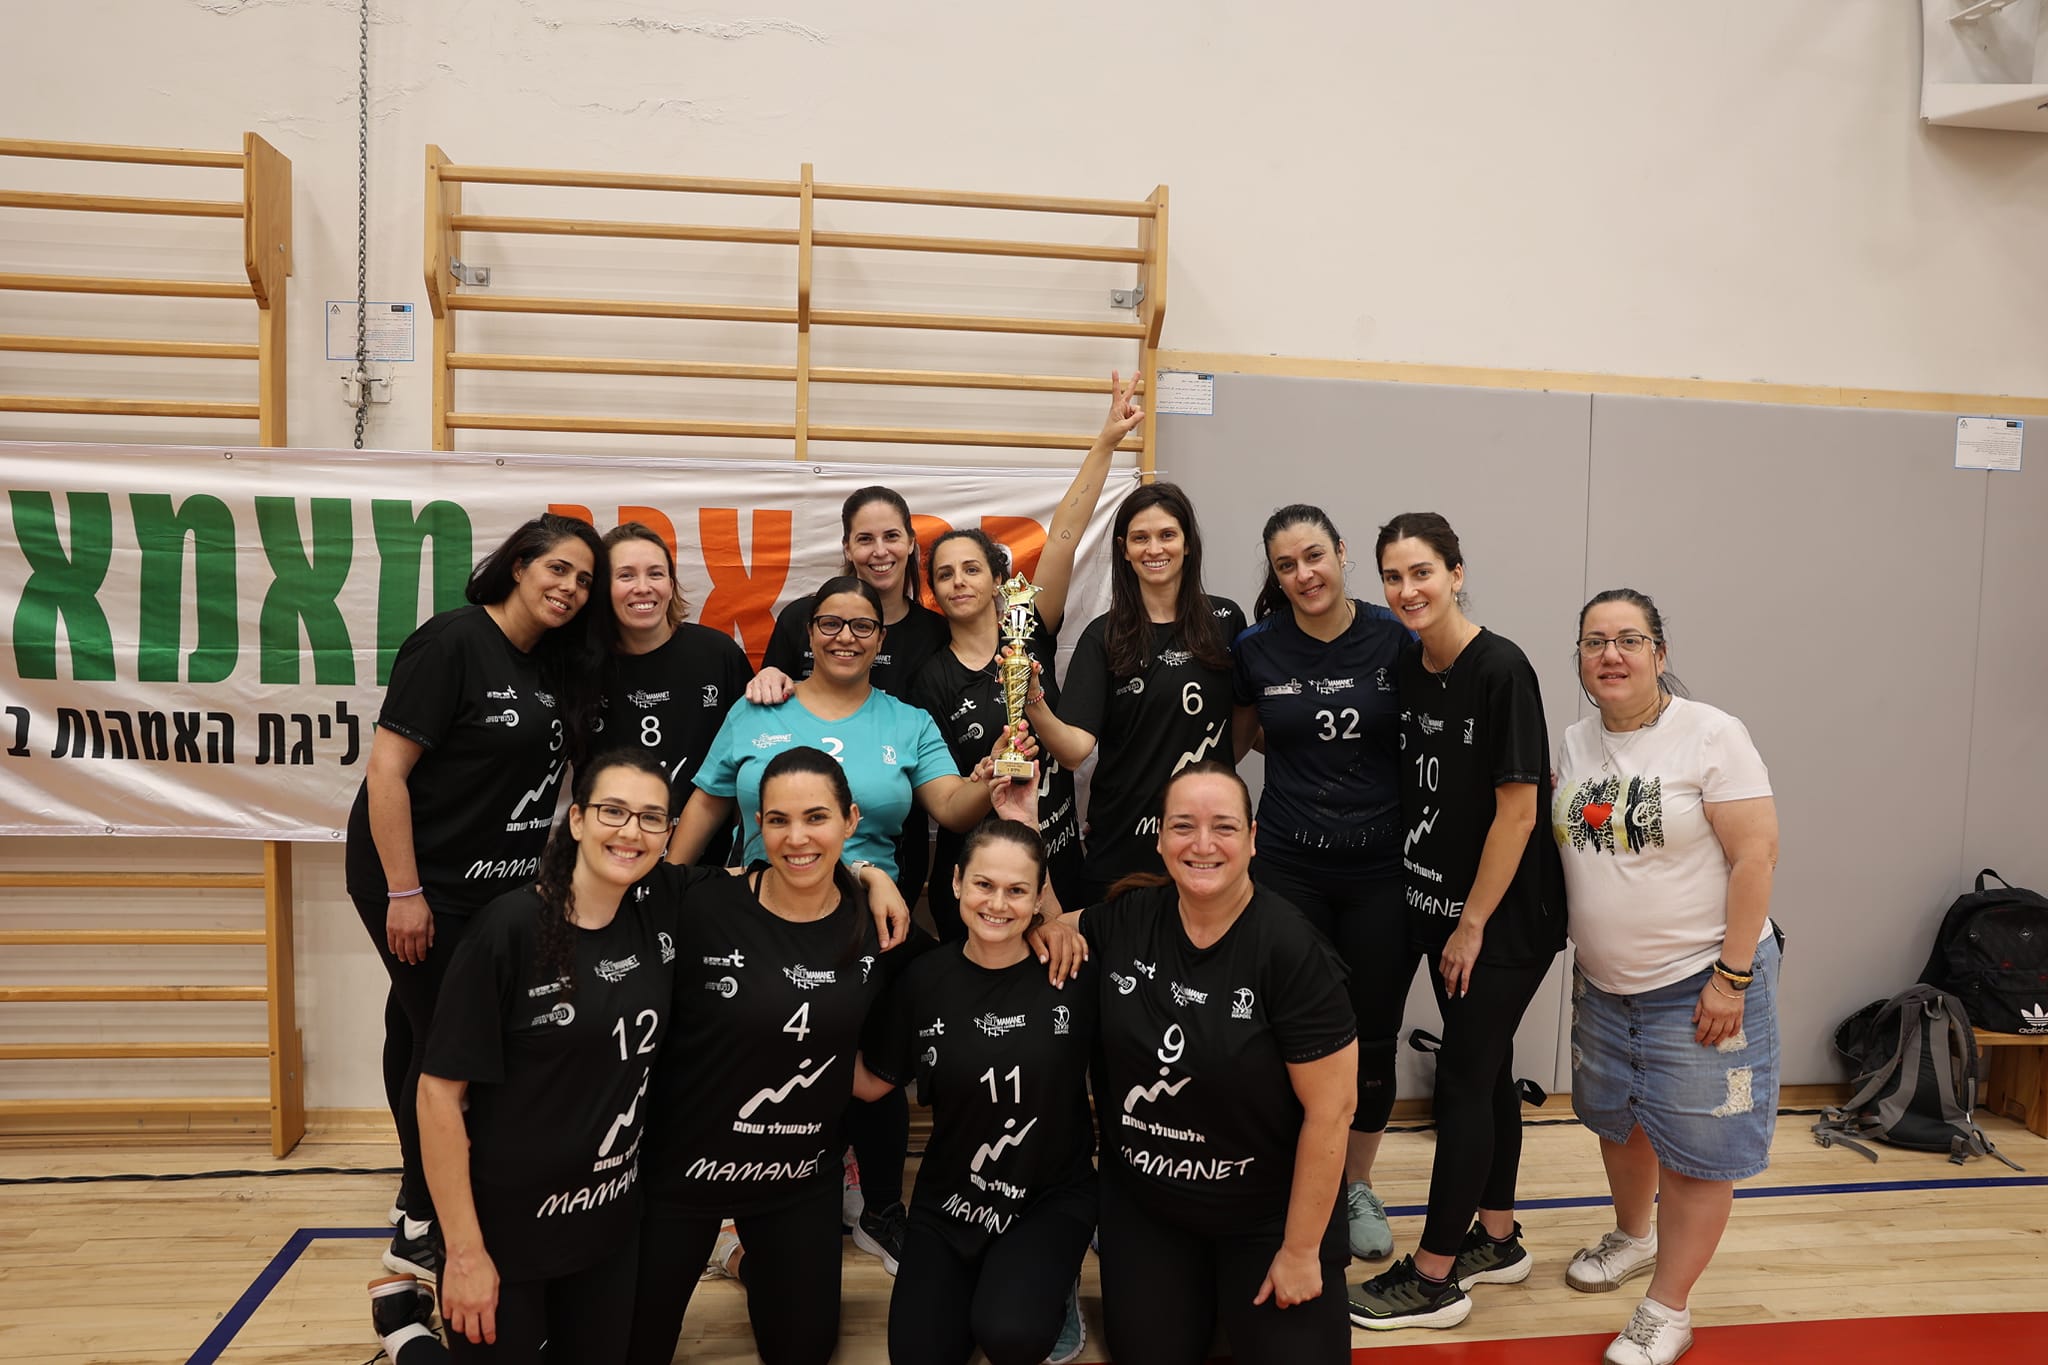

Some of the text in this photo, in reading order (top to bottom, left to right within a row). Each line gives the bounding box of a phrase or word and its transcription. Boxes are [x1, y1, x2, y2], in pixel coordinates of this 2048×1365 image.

[8, 490, 473, 686] מאמא
[1182, 681, 1204, 715] 6
[51, 707, 235, 763] האמהות
[255, 701, 360, 765] ליגת
[549, 719, 563, 751] 3
[641, 715, 662, 747] 8
[1315, 707, 1361, 741] 32
[821, 737, 845, 763] 2
[1415, 753, 1439, 792] 10
[506, 821, 528, 832] שחם
[1404, 884, 1465, 918] AMANE
[611, 1009, 659, 1061] 12
[783, 1002, 811, 1042] 4
[997, 1014, 1026, 1026] MAMANET
[1157, 1023, 1185, 1064] 9
[979, 1065, 1021, 1104] 11
[732, 1120, 822, 1135] אלטשולר שחם
[1121, 1114, 1206, 1143] אלטשולר שחם
[593, 1153, 625, 1173] שחם
[685, 1149, 826, 1182] MAMANET
[537, 1149, 640, 1218] MAMAN
[987, 1179, 1027, 1200] אלטולר
